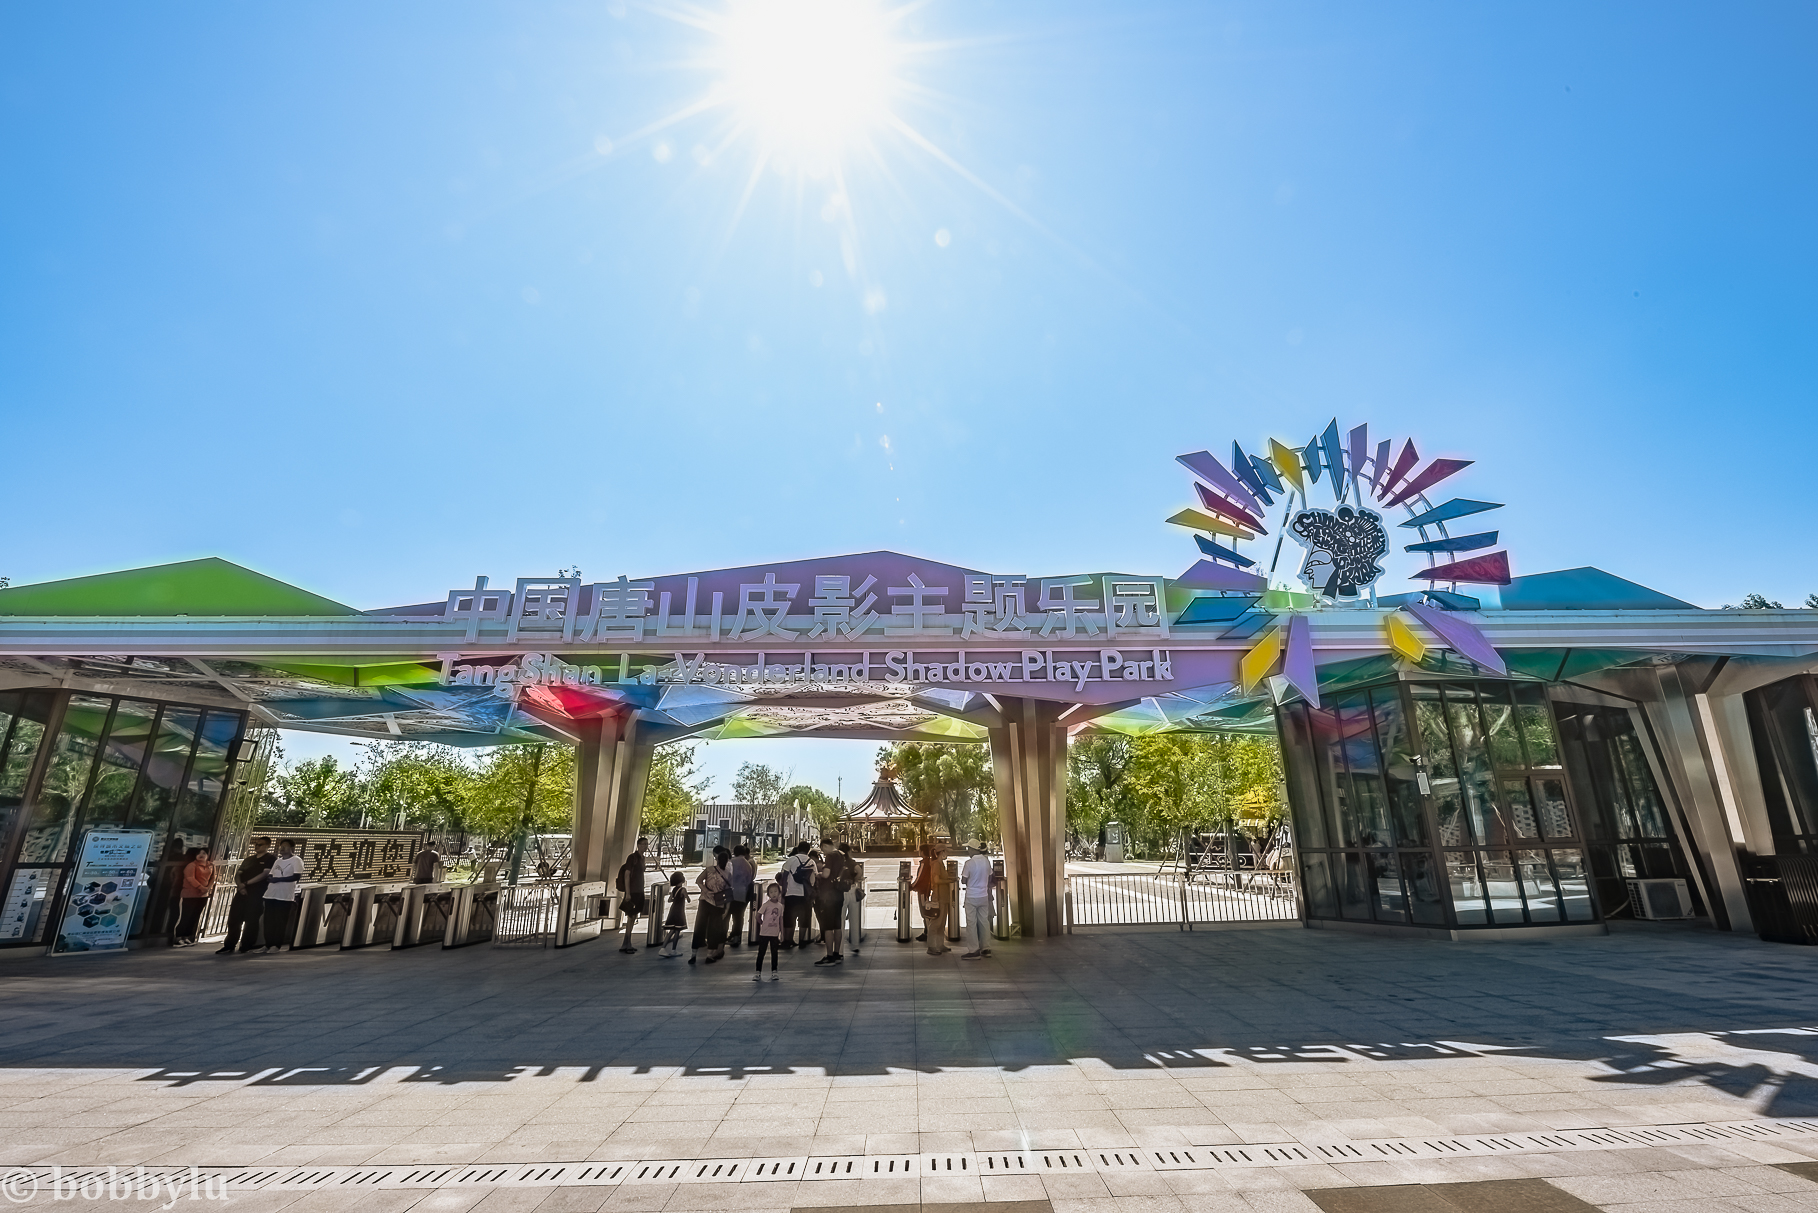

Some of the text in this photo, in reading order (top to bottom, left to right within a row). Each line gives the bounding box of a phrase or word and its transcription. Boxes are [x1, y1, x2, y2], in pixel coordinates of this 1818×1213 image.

[443, 572, 1171, 644] 中国唐山皮影主题乐园
[618, 652, 658, 686] La
[674, 651, 870, 686] Vonderland
[884, 650, 1013, 684] Shadow
[1021, 649, 1093, 692] Play
[1100, 649, 1174, 682] Park
